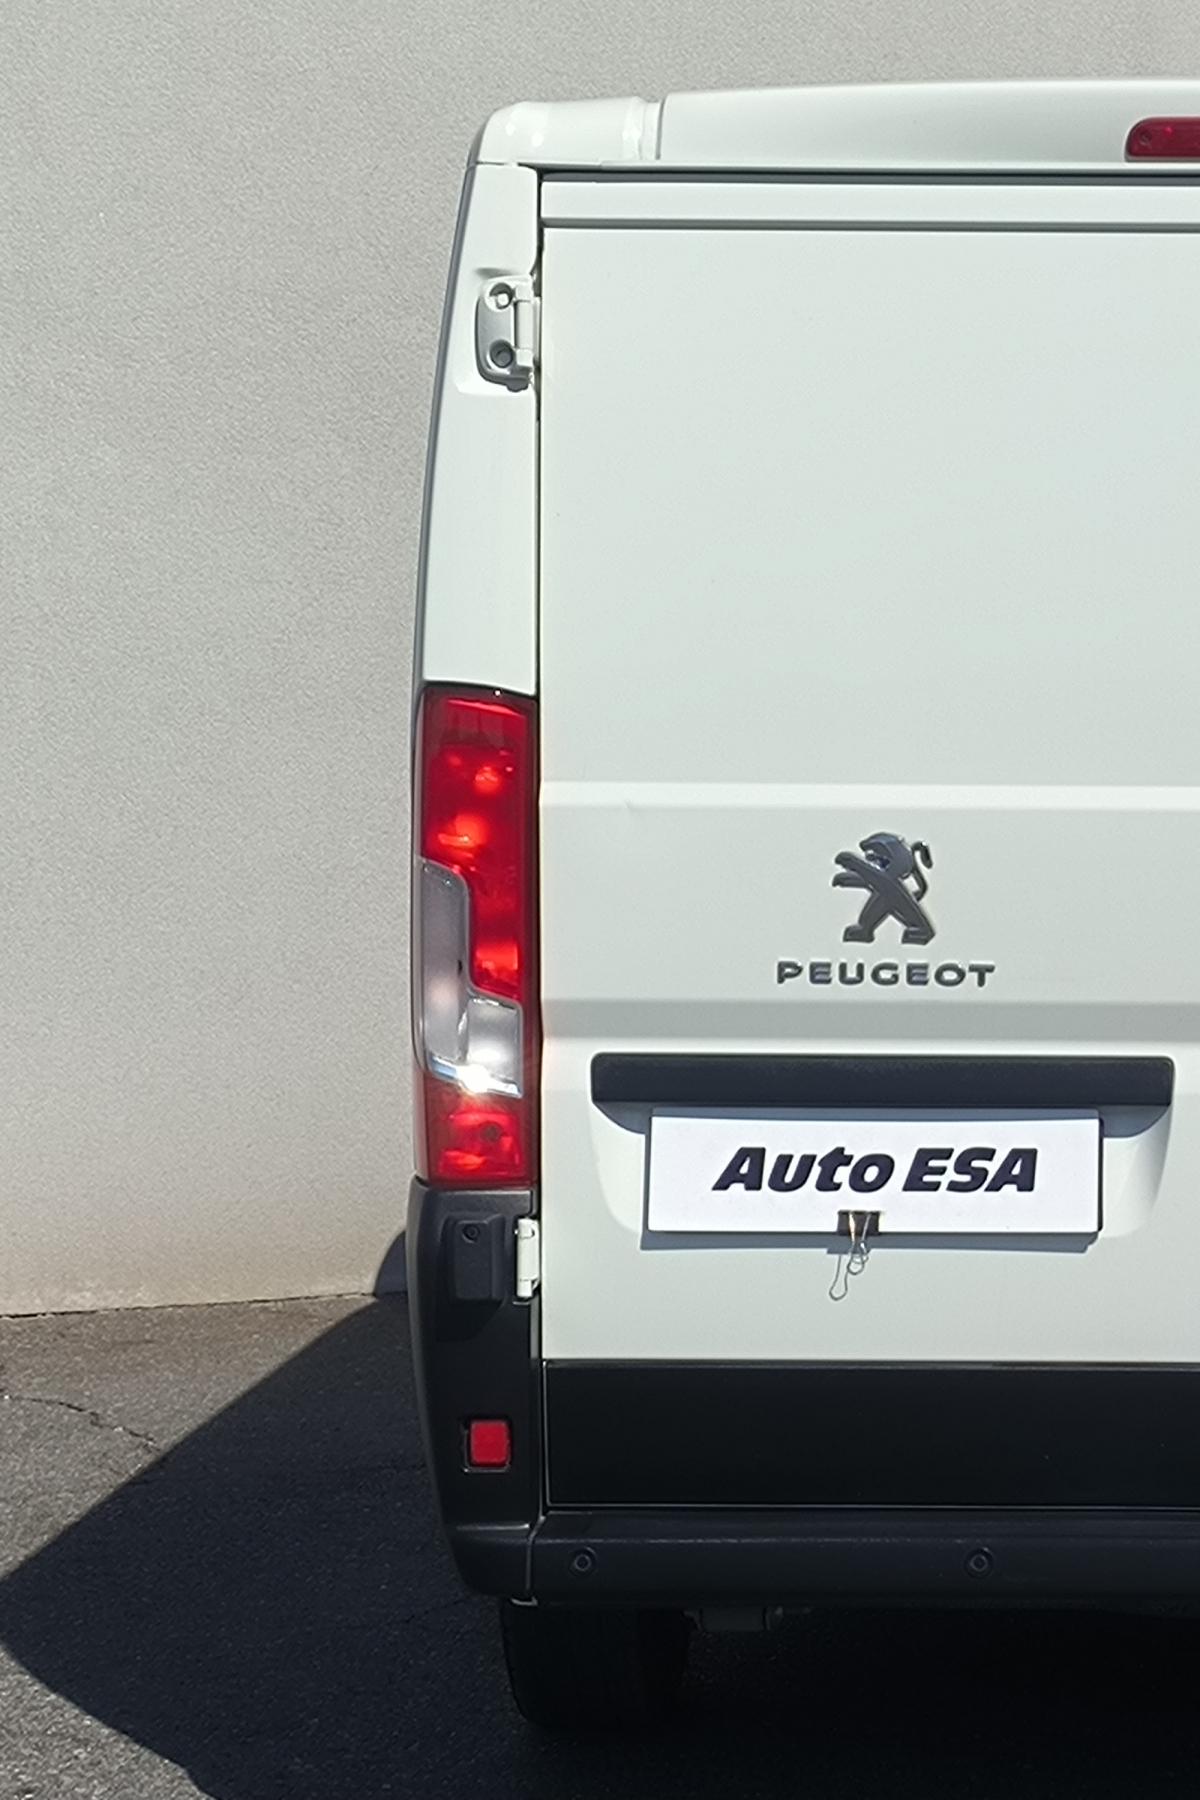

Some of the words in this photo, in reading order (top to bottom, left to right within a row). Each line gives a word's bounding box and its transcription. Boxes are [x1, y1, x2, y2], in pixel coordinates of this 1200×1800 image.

[776, 960, 996, 988] PEUGEOT
[711, 1146, 895, 1193] Auto
[902, 1147, 1038, 1193] ESA
